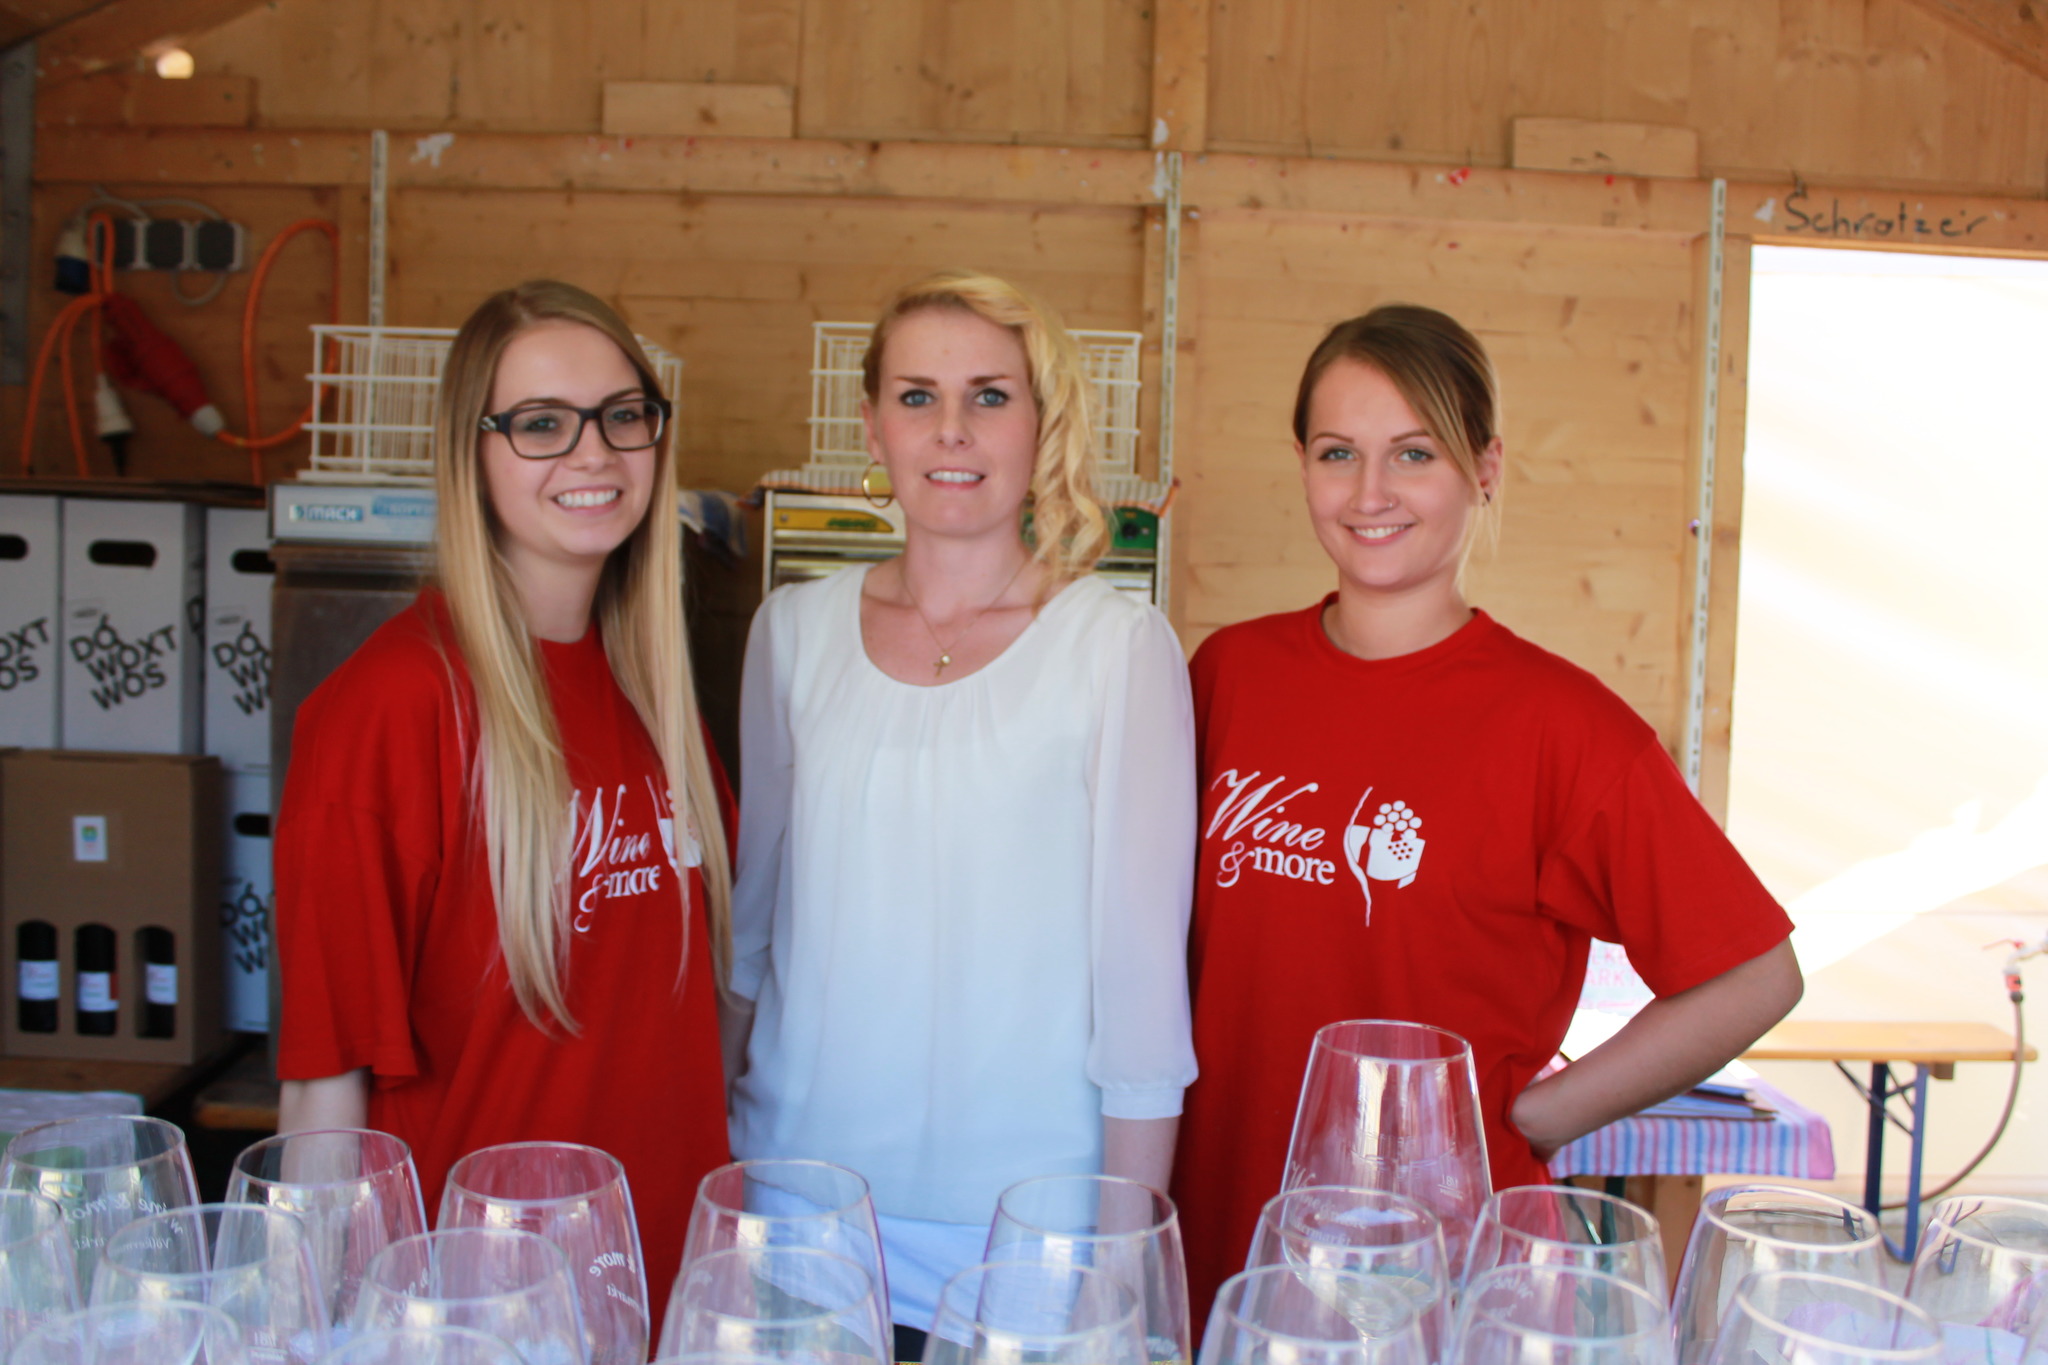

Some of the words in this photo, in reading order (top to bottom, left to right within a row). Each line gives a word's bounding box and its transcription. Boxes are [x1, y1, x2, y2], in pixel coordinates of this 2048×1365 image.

[86, 625, 177, 682] WOXT
[91, 663, 167, 711] WOS
[1205, 768, 1326, 851] Wine
